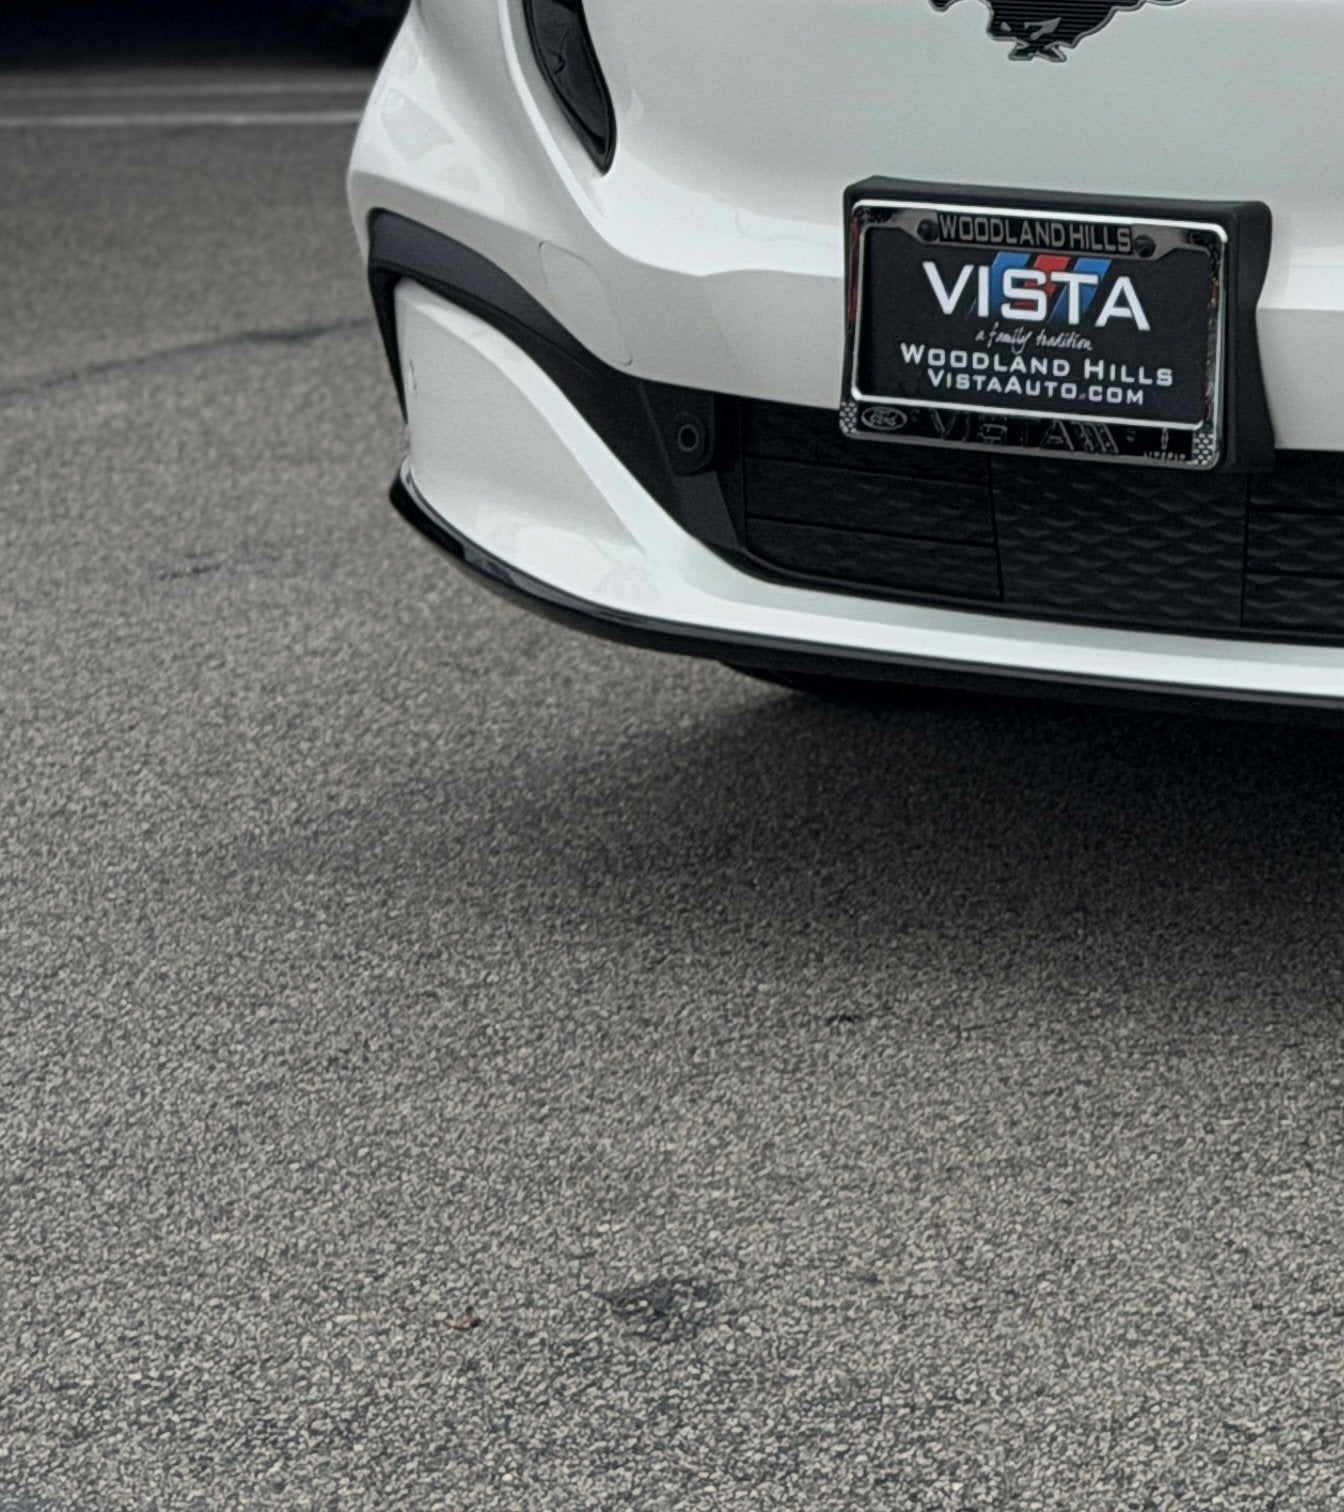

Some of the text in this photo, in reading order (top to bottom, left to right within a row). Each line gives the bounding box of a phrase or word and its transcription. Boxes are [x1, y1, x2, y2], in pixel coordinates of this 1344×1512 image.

[938, 213, 1132, 253] WOODLAND HILLS
[922, 261, 1151, 331] VISTA
[986, 321, 1032, 355] family
[1035, 328, 1094, 351] tradition
[900, 342, 1173, 387] WOODLAND HILLS
